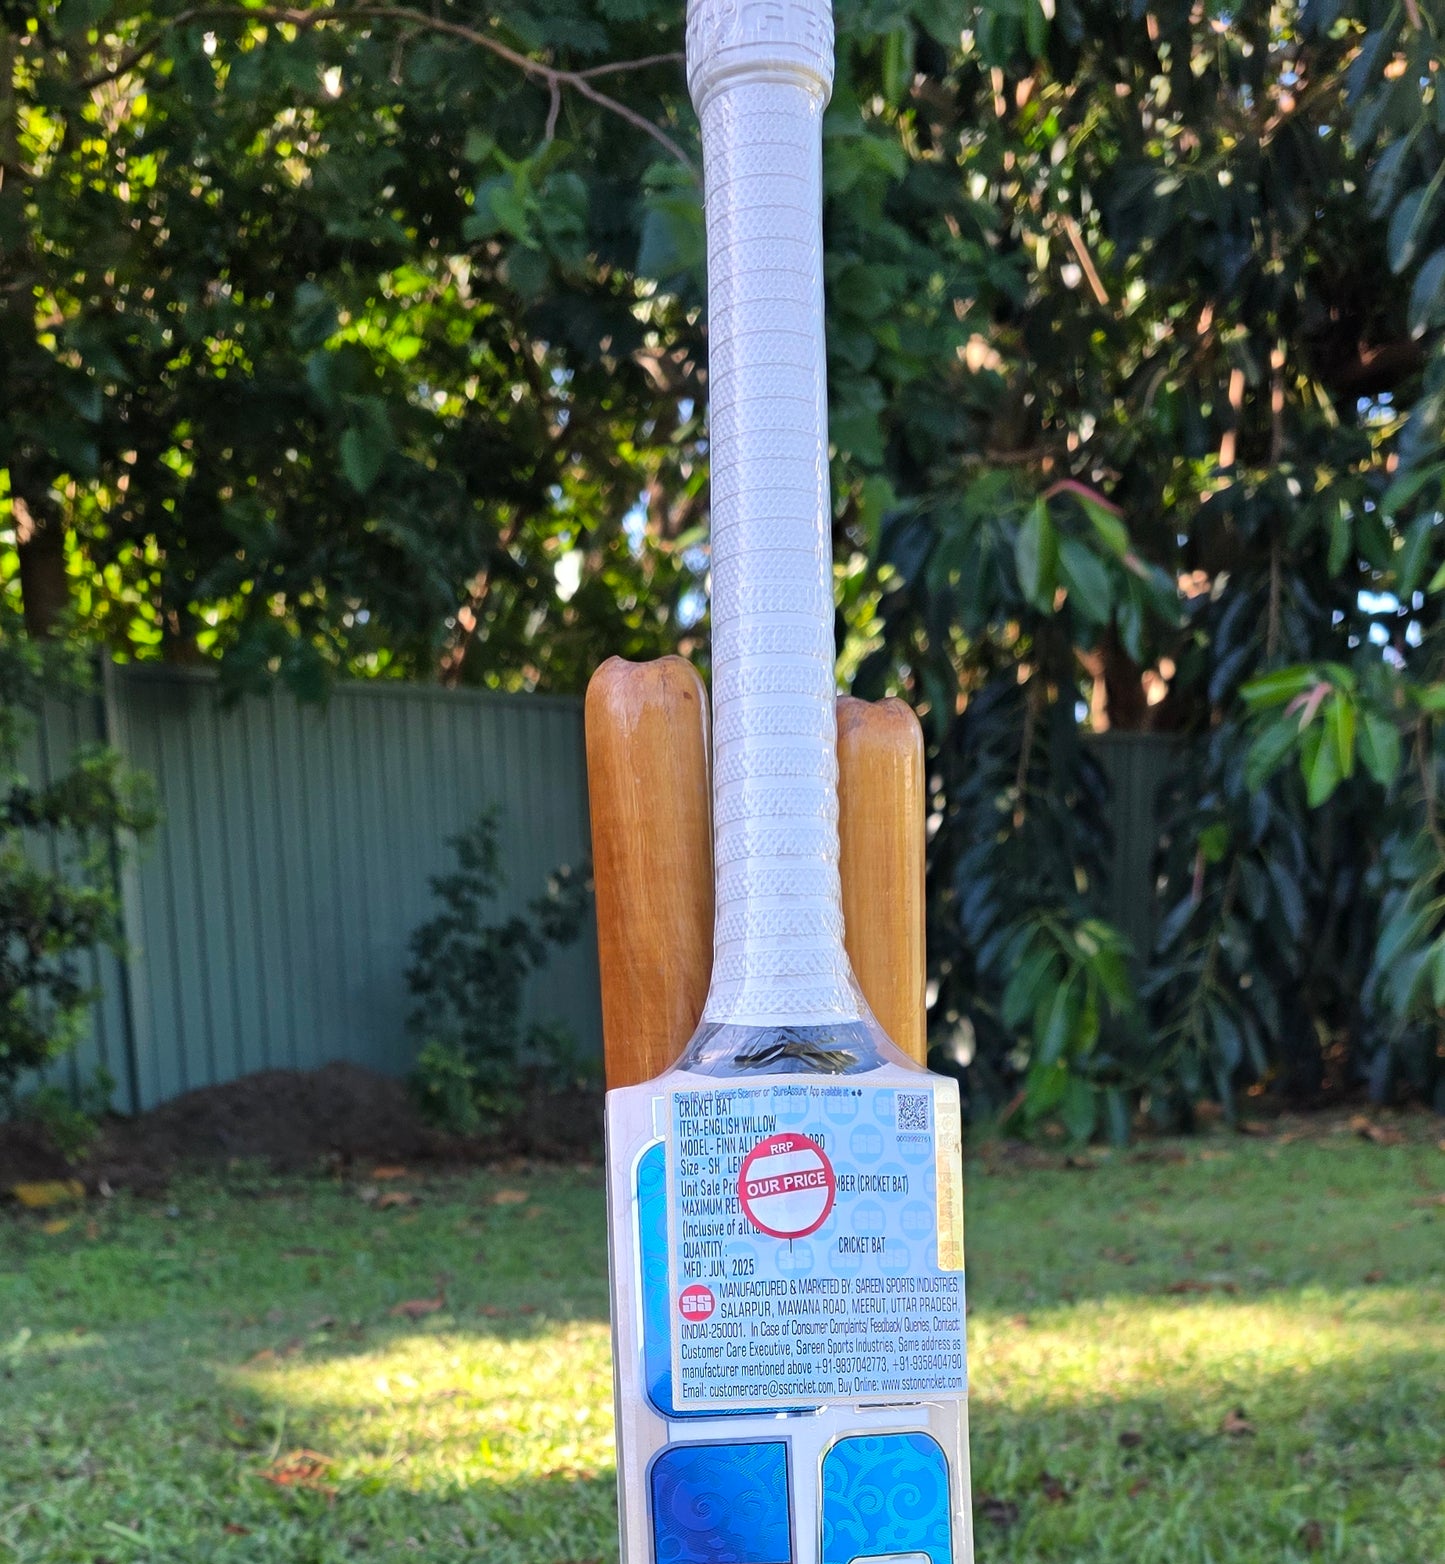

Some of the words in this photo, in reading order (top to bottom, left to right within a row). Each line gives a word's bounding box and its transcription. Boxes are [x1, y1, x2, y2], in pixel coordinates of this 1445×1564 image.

[680, 1098, 713, 1118] CRICKET
[716, 1098, 732, 1116] BAT
[680, 1117, 740, 1137] ITEM-ENGLISH
[742, 1114, 776, 1132] WILLOW
[680, 1138, 714, 1156] MODEL-
[716, 1136, 736, 1154] FINN
[770, 1141, 794, 1155] RRP
[680, 1157, 699, 1176] Size
[708, 1157, 720, 1174] SH
[728, 1155, 747, 1174] LEN
[681, 1180, 698, 1198] Unit
[700, 1178, 720, 1196] Sale
[722, 1178, 740, 1196] Pric
[834, 1174, 856, 1192] MBER
[858, 1174, 890, 1194] (CRICKET
[892, 1174, 909, 1194] BAT)
[747, 1179, 780, 1197] OUR
[784, 1172, 826, 1190] PRICE
[682, 1199, 722, 1216] MAXIMUM
[726, 1198, 744, 1215] RET
[682, 1219, 724, 1239] (Inclusive
[726, 1220, 736, 1236] of
[738, 1218, 750, 1236] all
[683, 1240, 724, 1258] QUANTITY
[838, 1236, 870, 1254] CRICKET
[872, 1236, 886, 1254] BAT
[684, 1261, 701, 1278] MFD
[708, 1260, 728, 1280] JUN,
[732, 1258, 755, 1276] 2025
[720, 1280, 788, 1298] MANUFACTURED
[790, 1280, 797, 1295] &
[798, 1278, 840, 1295] MARKETED
[842, 1278, 854, 1294] BY:
[856, 1278, 884, 1294] SAREEN
[886, 1277, 915, 1294] SPORTS
[916, 1276, 960, 1294] INDUSTRIES,
[682, 1294, 712, 1313] SS
[721, 1301, 774, 1318] SALARPUR,
[778, 1299, 820, 1316] MAWANA
[823, 1298, 849, 1316] ROAD,
[852, 1298, 888, 1314] MEERUT,
[891, 1297, 917, 1313] UTTAR
[920, 1296, 960, 1313] PRADESH,
[751, 1322, 759, 1337] In
[760, 1321, 780, 1336] Case
[782, 1320, 790, 1336] of
[792, 1320, 828, 1336] Consumer
[682, 1344, 724, 1360] Customer
[726, 1342, 747, 1358] Care
[750, 1340, 794, 1357] Executive,
[796, 1340, 826, 1355] Sareen
[828, 1338, 854, 1358] Sports
[856, 1336, 896, 1354] Industries,
[898, 1336, 920, 1352] Same
[922, 1336, 951, 1352] address
[952, 1339, 961, 1350] as
[682, 1362, 740, 1378] manufacturer
[742, 1360, 785, 1376] mentioned
[788, 1359, 812, 1375] above
[892, 1354, 962, 1371] +91-9358404790
[682, 1382, 707, 1398] Email:
[838, 1378, 852, 1396] Buy
[854, 1376, 880, 1392] Online:
